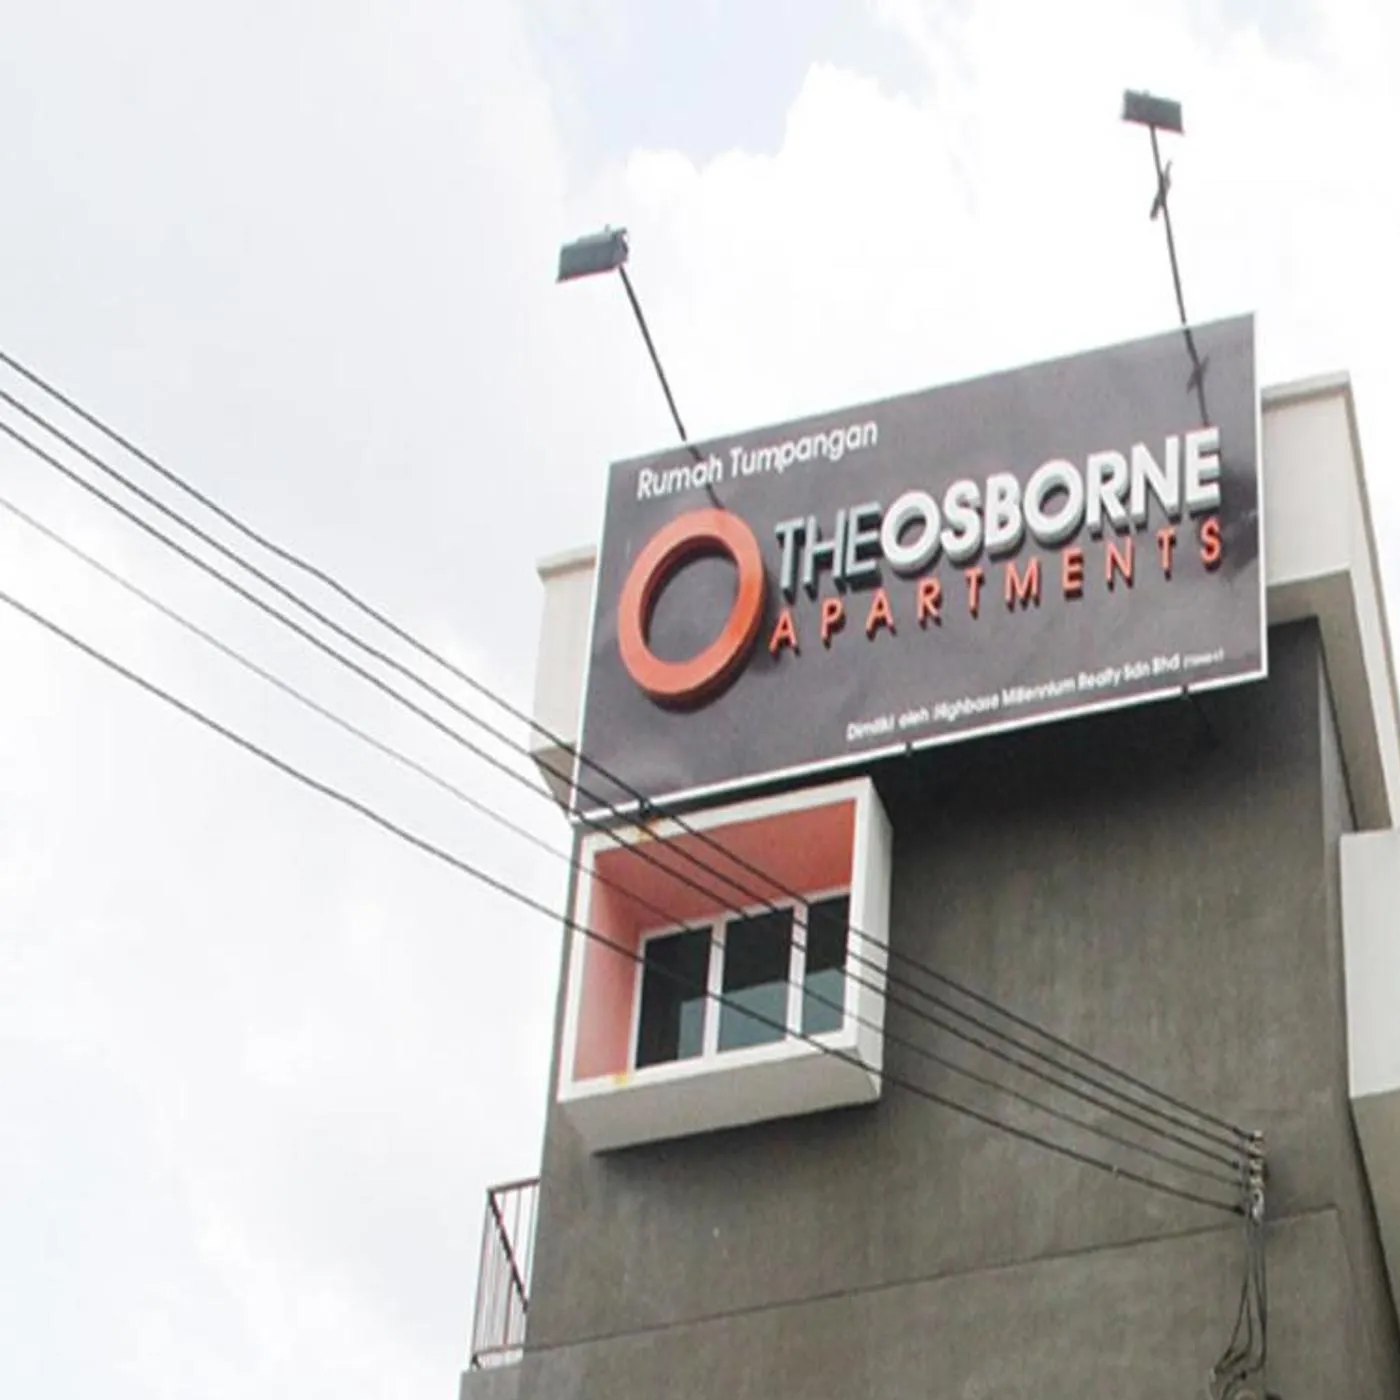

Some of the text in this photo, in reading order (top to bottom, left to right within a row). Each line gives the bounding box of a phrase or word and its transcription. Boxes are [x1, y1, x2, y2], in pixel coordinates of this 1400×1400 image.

[636, 420, 878, 501] Rumah Tumpangan
[769, 518, 1222, 653] APARTMENTS
[1078, 666, 1121, 692] Realty
[1122, 660, 1150, 682] Sdn
[1151, 652, 1181, 677] Bhd
